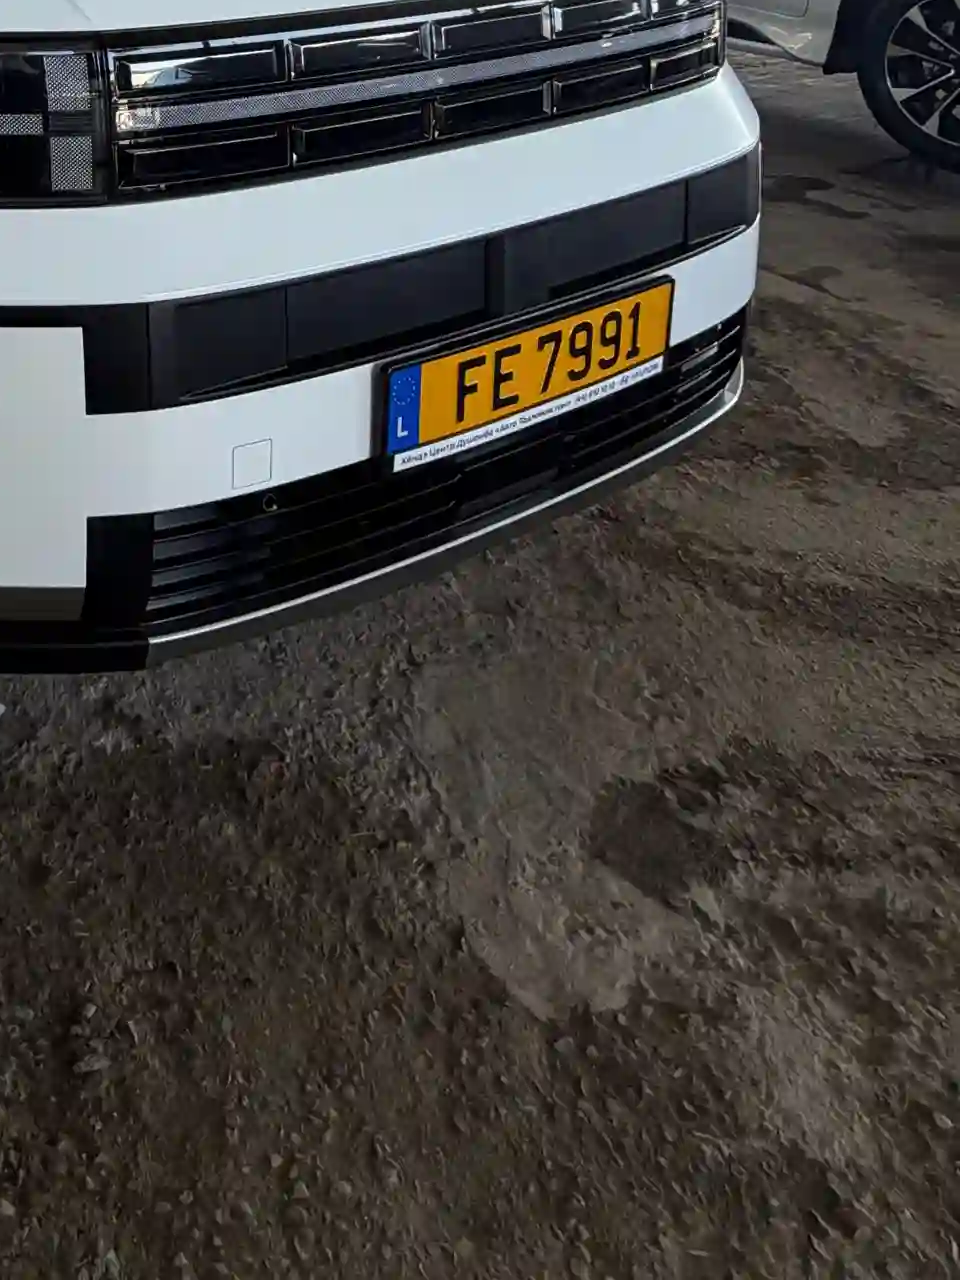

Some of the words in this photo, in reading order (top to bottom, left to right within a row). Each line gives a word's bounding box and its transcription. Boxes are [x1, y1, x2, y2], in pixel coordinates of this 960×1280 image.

[456, 344, 522, 423] FE
[537, 301, 642, 395] 7991
[396, 416, 409, 438] L
